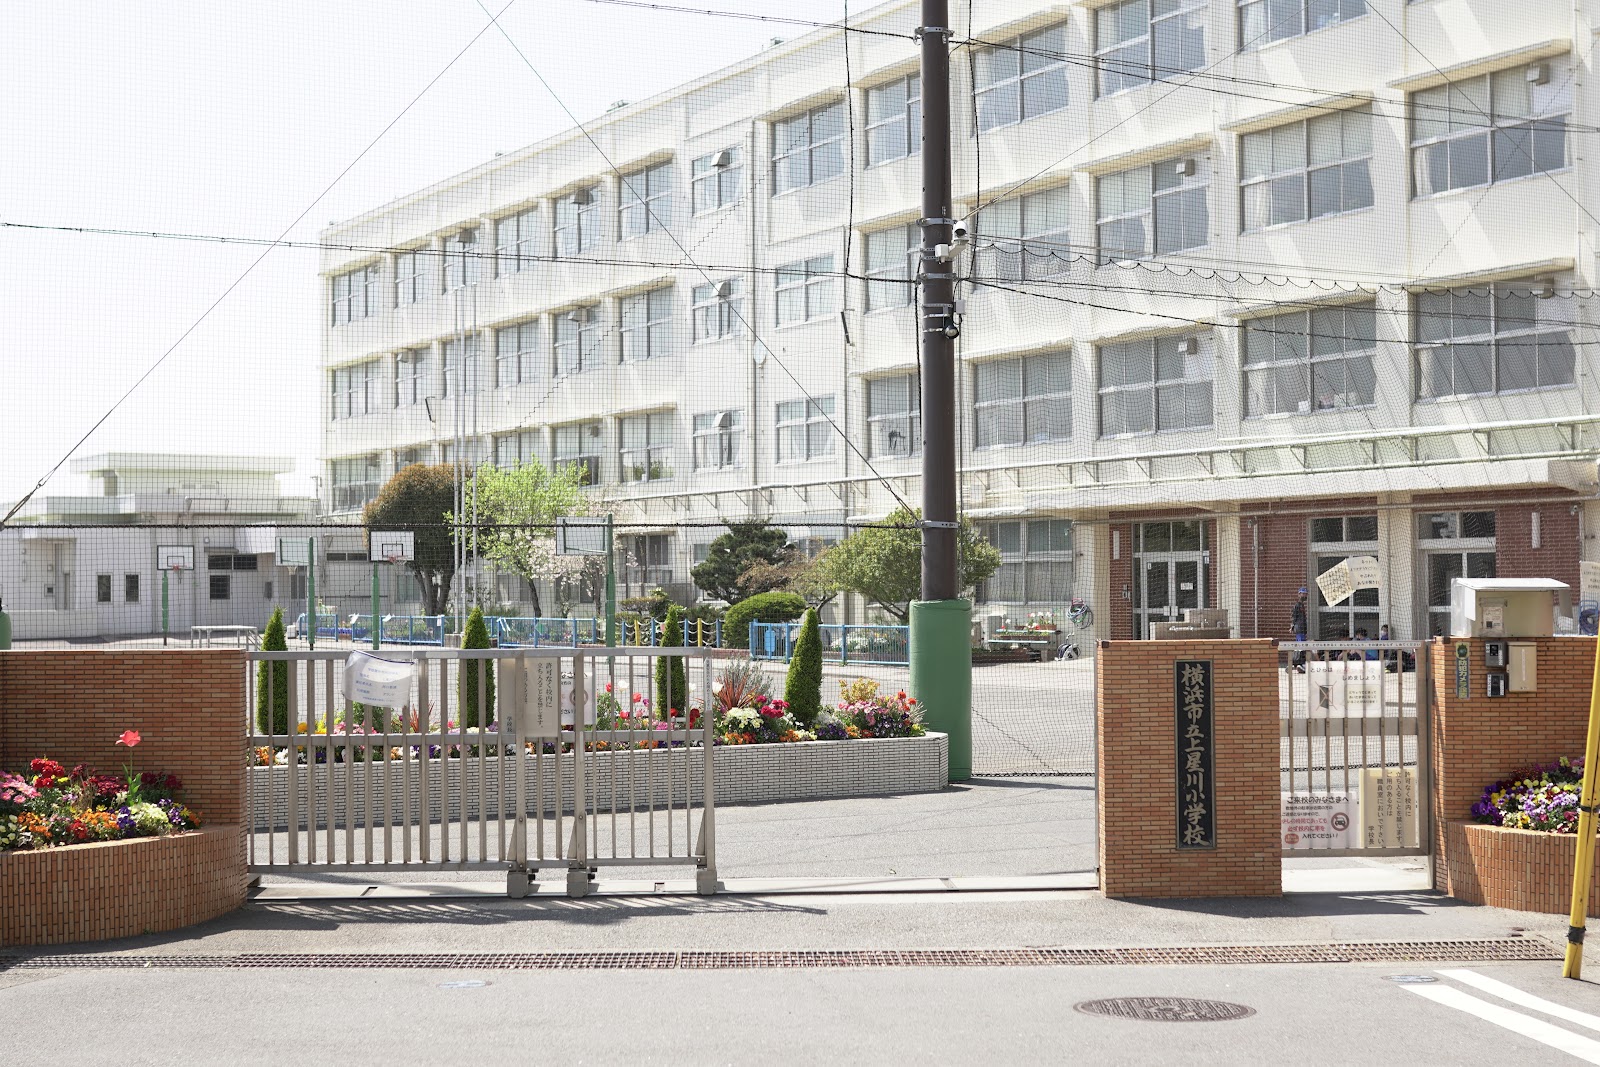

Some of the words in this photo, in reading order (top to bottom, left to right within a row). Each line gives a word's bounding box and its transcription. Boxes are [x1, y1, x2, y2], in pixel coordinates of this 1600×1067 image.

[536, 662, 544, 728] 立ち入ることを禁じます。
[545, 662, 553, 708] 許可なく校内に
[1181, 664, 1210, 845] 横浜市立上星川小学校
[1287, 796, 1349, 804] ご来校のみなさまへ
[1404, 771, 1412, 817] 許可なく校内に
